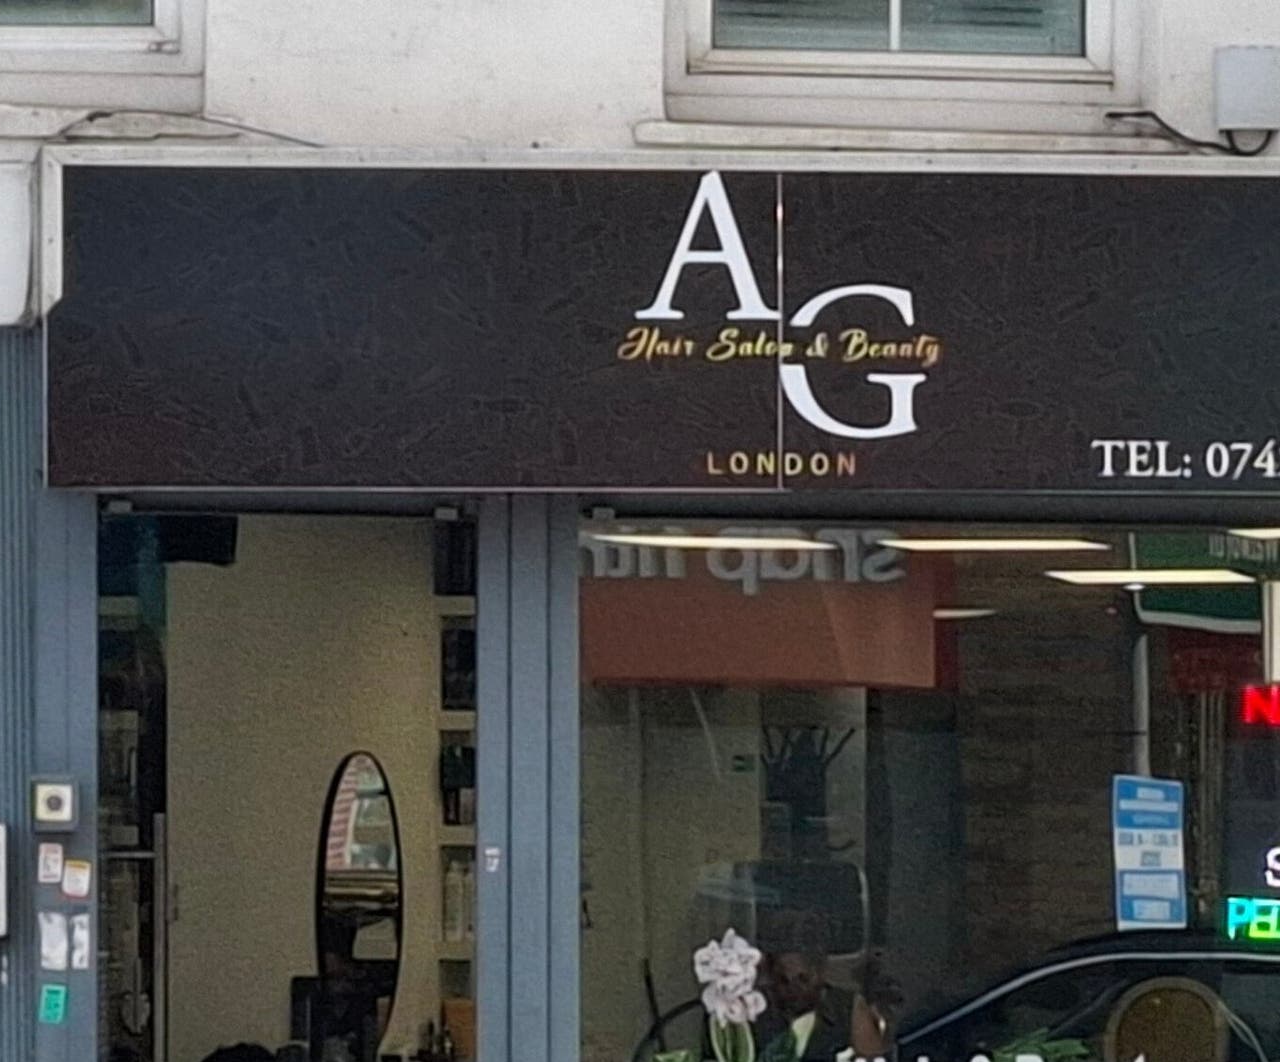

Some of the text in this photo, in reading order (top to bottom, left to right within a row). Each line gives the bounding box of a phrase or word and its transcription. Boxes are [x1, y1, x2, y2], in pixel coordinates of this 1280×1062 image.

[617, 325, 695, 362] Hair
[804, 332, 830, 358] &
[707, 451, 857, 477] LONDON
[1091, 438, 1193, 479] TEL:
